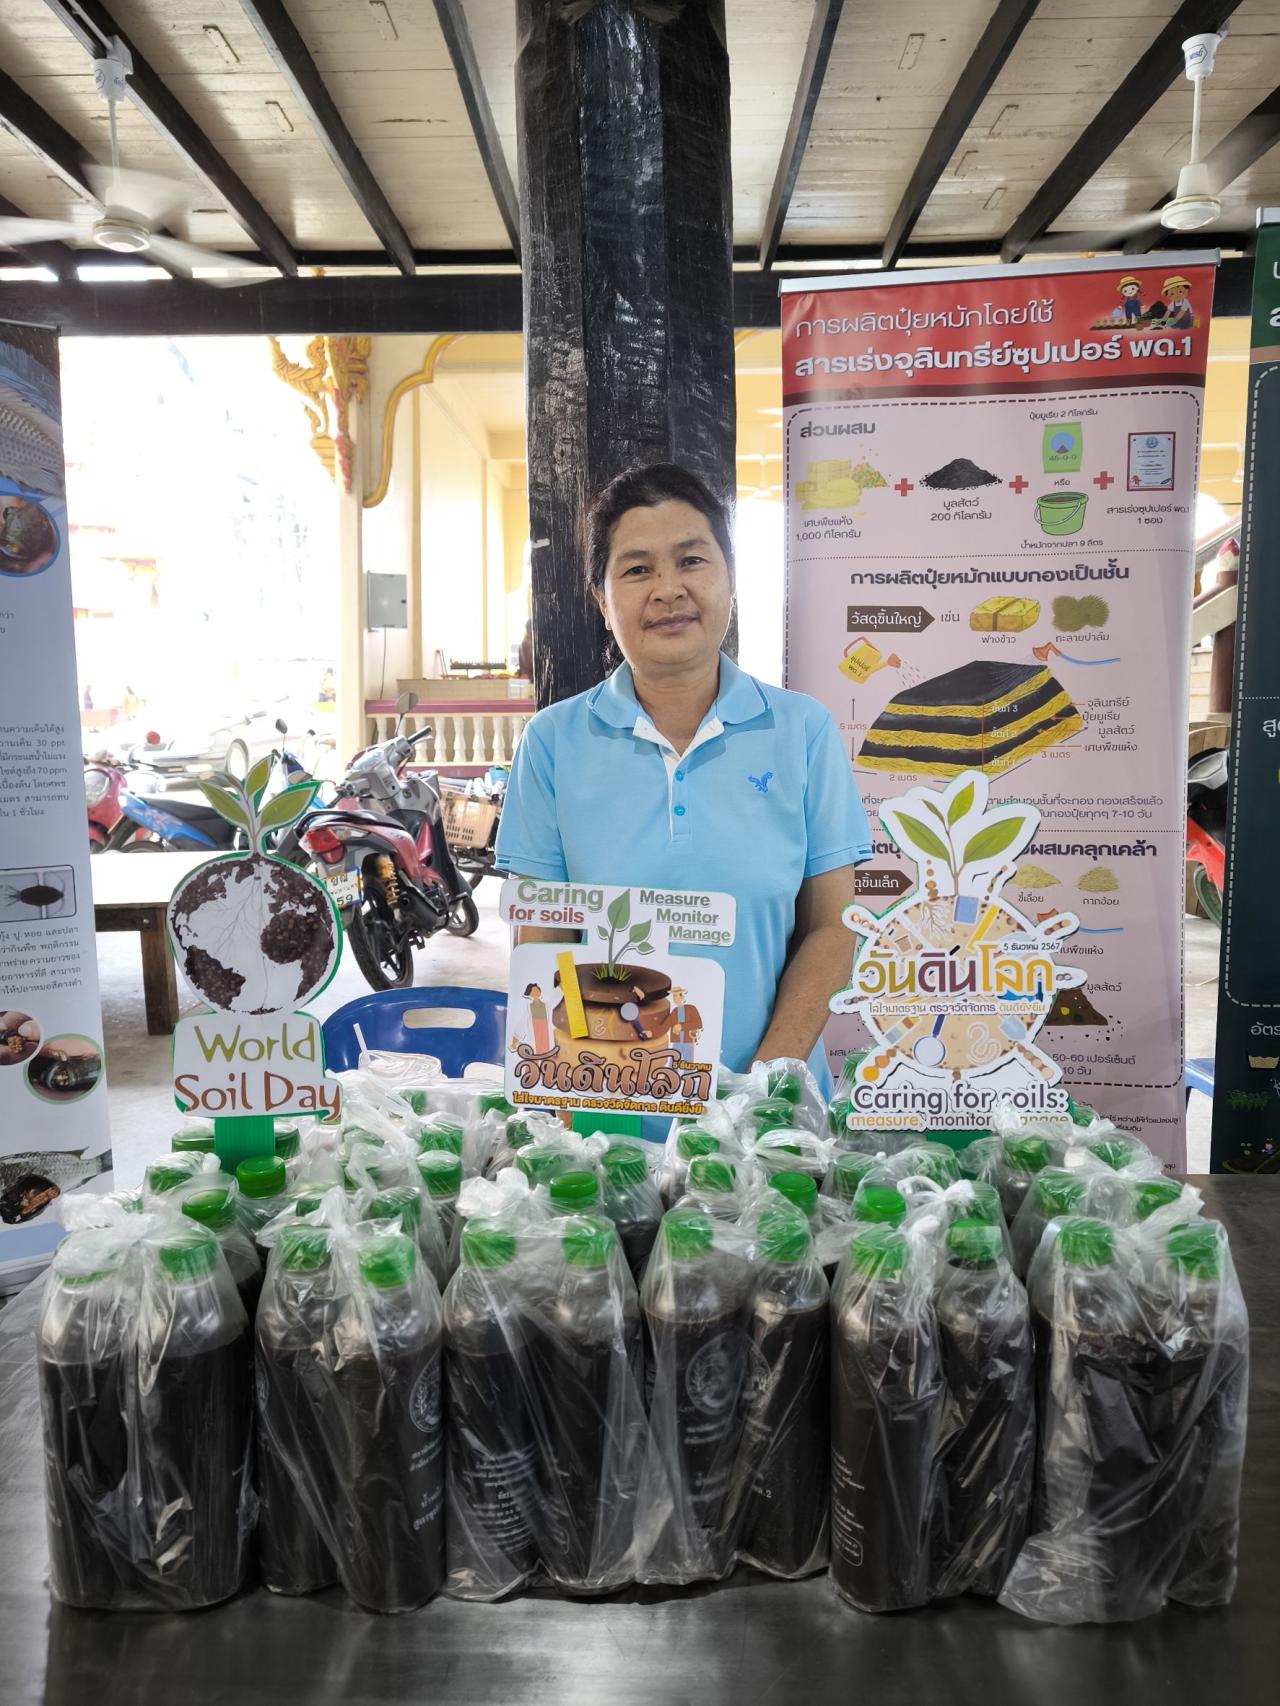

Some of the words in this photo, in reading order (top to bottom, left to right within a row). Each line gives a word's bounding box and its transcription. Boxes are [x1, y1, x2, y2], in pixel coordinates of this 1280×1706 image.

[796, 298, 1054, 338] การผลิตปุ๋ยหมักโดยใช้
[795, 335, 1123, 378] สารเร่งจุลินทรีย์ซุปเปอร์
[1129, 336, 1192, 358] พด.1
[1068, 409, 1098, 418] กิโลกรัม
[800, 421, 876, 438] ส่วนผสม
[1054, 478, 1071, 487] หรือ
[943, 497, 980, 511] มูลสัตว์
[1106, 503, 1173, 516] สารเร่งซุปเปอร์
[930, 511, 951, 522] 200
[953, 508, 992, 521] กิโลกรัม
[1144, 517, 1163, 525] ซอง
[796, 531, 821, 542] 1,000
[823, 528, 862, 539] กิโลกรัม
[1080, 539, 1086, 547] 9
[1087, 537, 1104, 547] ลิตร
[850, 558, 1130, 590] การผลิตปุ๋ยหมักแบบกองเป็นชั้น
[851, 608, 923, 628] วัสดุชิ้นใหญ่
[941, 611, 961, 623] เช่น
[981, 633, 1017, 644] ฟางข้าว
[1088, 697, 1130, 711] จุลินทรีย์
[1082, 711, 1121, 724] ปุ๋ยยูเรีย
[1098, 725, 1135, 739] มูลสัตว์
[37, 739, 47, 747] 30
[50, 740, 65, 748] ppt
[1085, 742, 1138, 752] เศษพืชแห้ง
[1050, 751, 1071, 759] เมตร
[38, 767, 48, 775] 70
[49, 767, 68, 776] ppm
[898, 774, 918, 782] เมตร
[1097, 794, 1164, 806] กองเสร็จแล้ว
[1040, 810, 1109, 821] ับกองปุ๋ยทุกๆ
[1112, 811, 1135, 819] 7-10
[1137, 810, 1153, 819] วัน
[517, 880, 603, 912] Caring
[640, 889, 711, 907] Measure
[1018, 891, 1044, 903] ขี้เลื่อย
[1083, 897, 1119, 906] กากอ้อย
[508, 904, 535, 921] for
[540, 907, 585, 923] soils
[656, 908, 720, 924] Monitor
[45, 927, 79, 937] และปลา
[668, 926, 731, 943] Manage
[1003, 942, 1009, 951] 5
[1011, 940, 1039, 951] ธันวาคม
[1041, 941, 1061, 951] 2567
[50, 966, 81, 976] สามารถ
[858, 944, 1053, 994] วันดินโลก
[1087, 982, 1122, 994] มูลสัตว์
[929, 1001, 996, 1013] ตรวจวัดจัดการ
[194, 1022, 315, 1063] World
[1086, 1054, 1136, 1065] เปอร์เซ็นต์
[1077, 1066, 1092, 1075] วัน
[174, 1072, 253, 1112] Soil
[263, 1070, 341, 1122] Day
[854, 1085, 943, 1114] Caring
[954, 1084, 992, 1107] for
[851, 1115, 923, 1128] measure,
[930, 1112, 992, 1127] monitor
